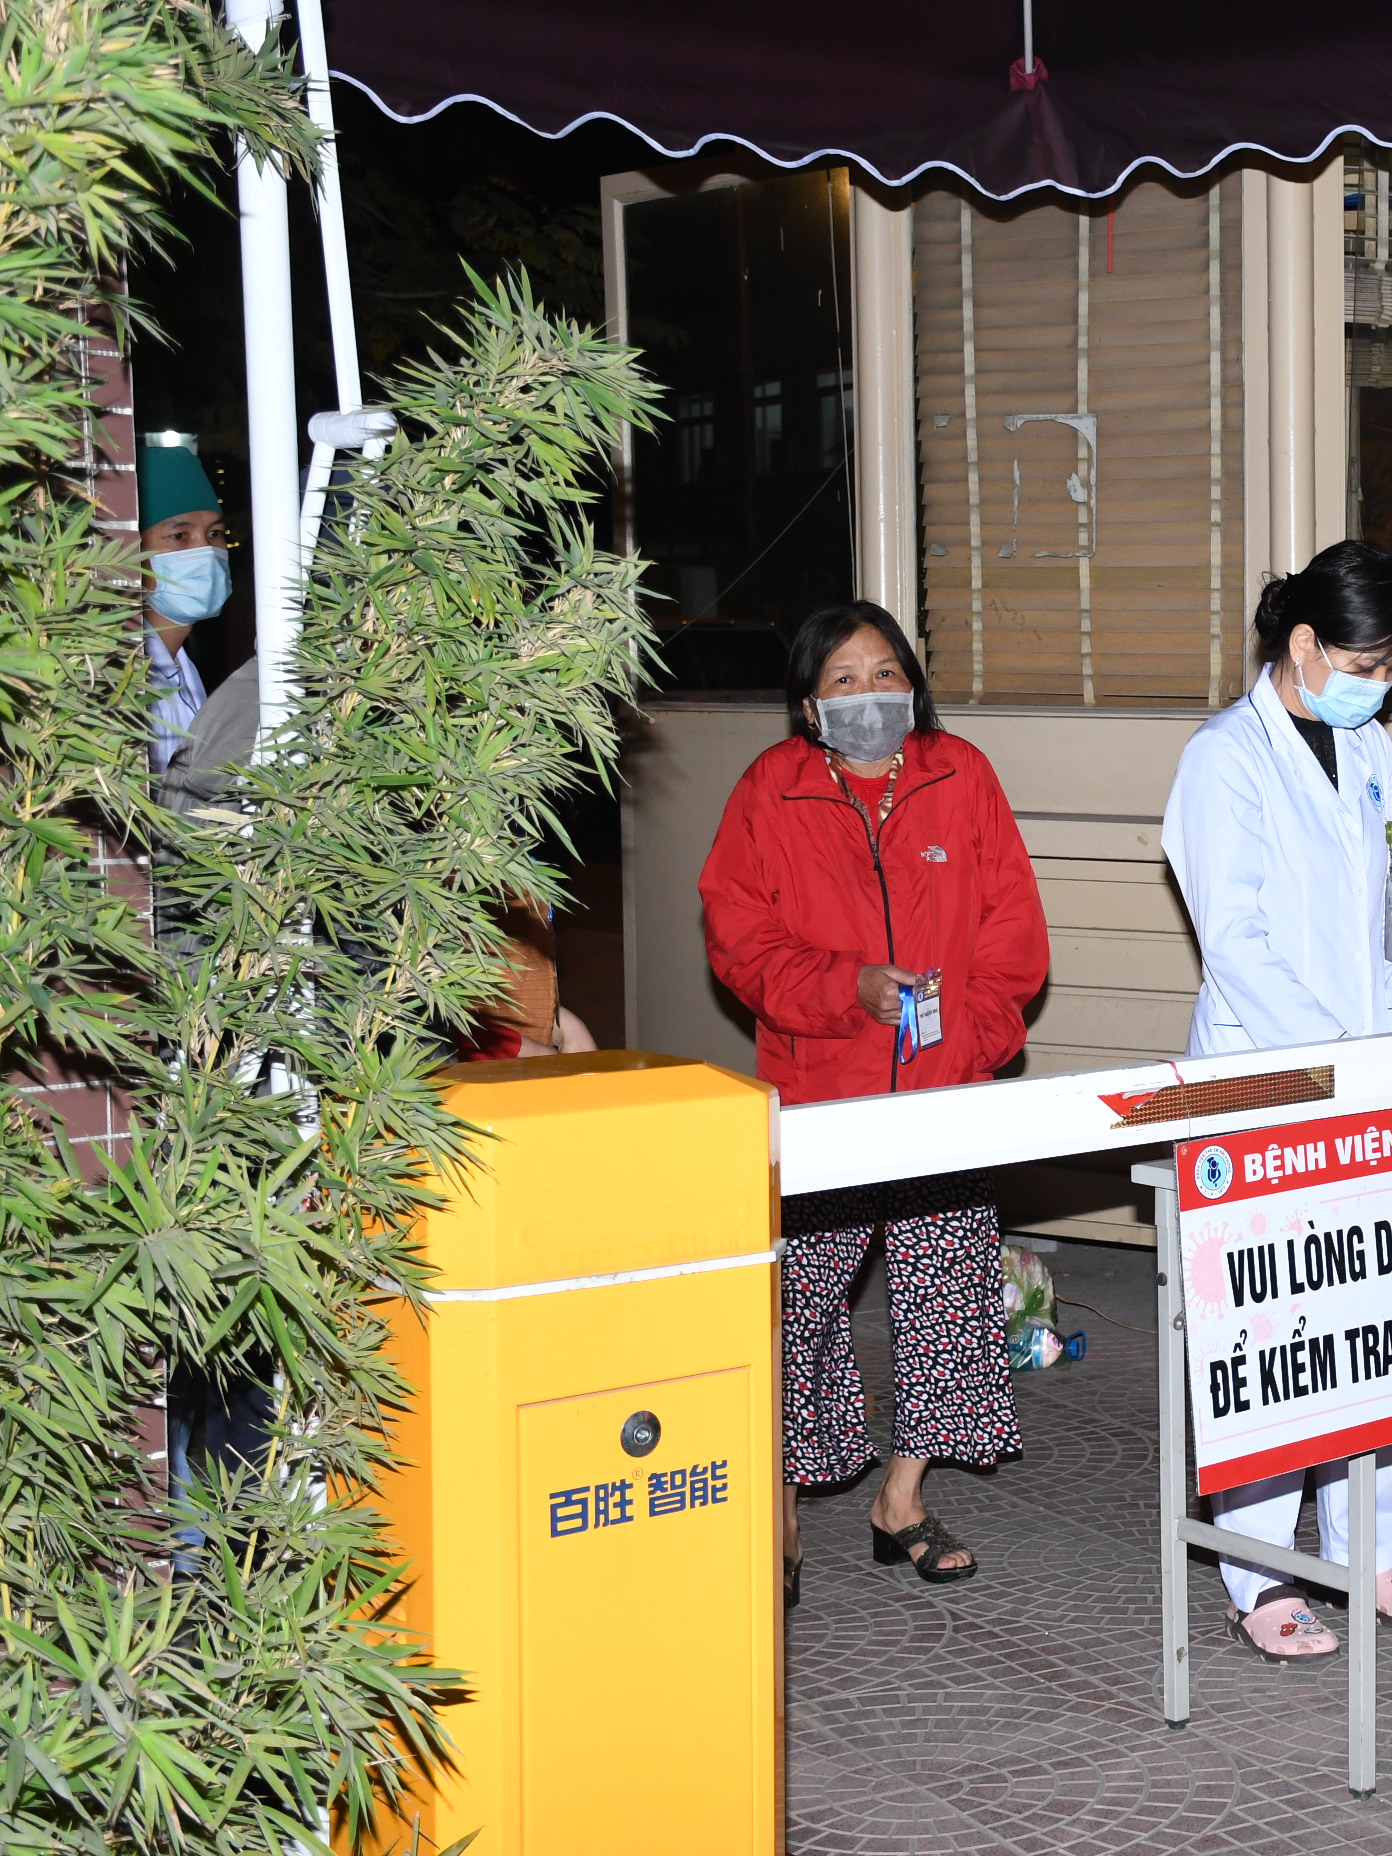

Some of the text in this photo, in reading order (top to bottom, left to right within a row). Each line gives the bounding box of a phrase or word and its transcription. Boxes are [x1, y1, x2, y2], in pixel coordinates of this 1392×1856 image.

[1244, 1143, 1326, 1184] BỆNH
[1226, 1243, 1279, 1308] VUI
[1286, 1220, 1366, 1295] LÒNG
[1209, 1329, 1251, 1419] ĐỂ
[1259, 1315, 1338, 1406] KIỂM
[549, 1459, 728, 1538] 百胜 智能
